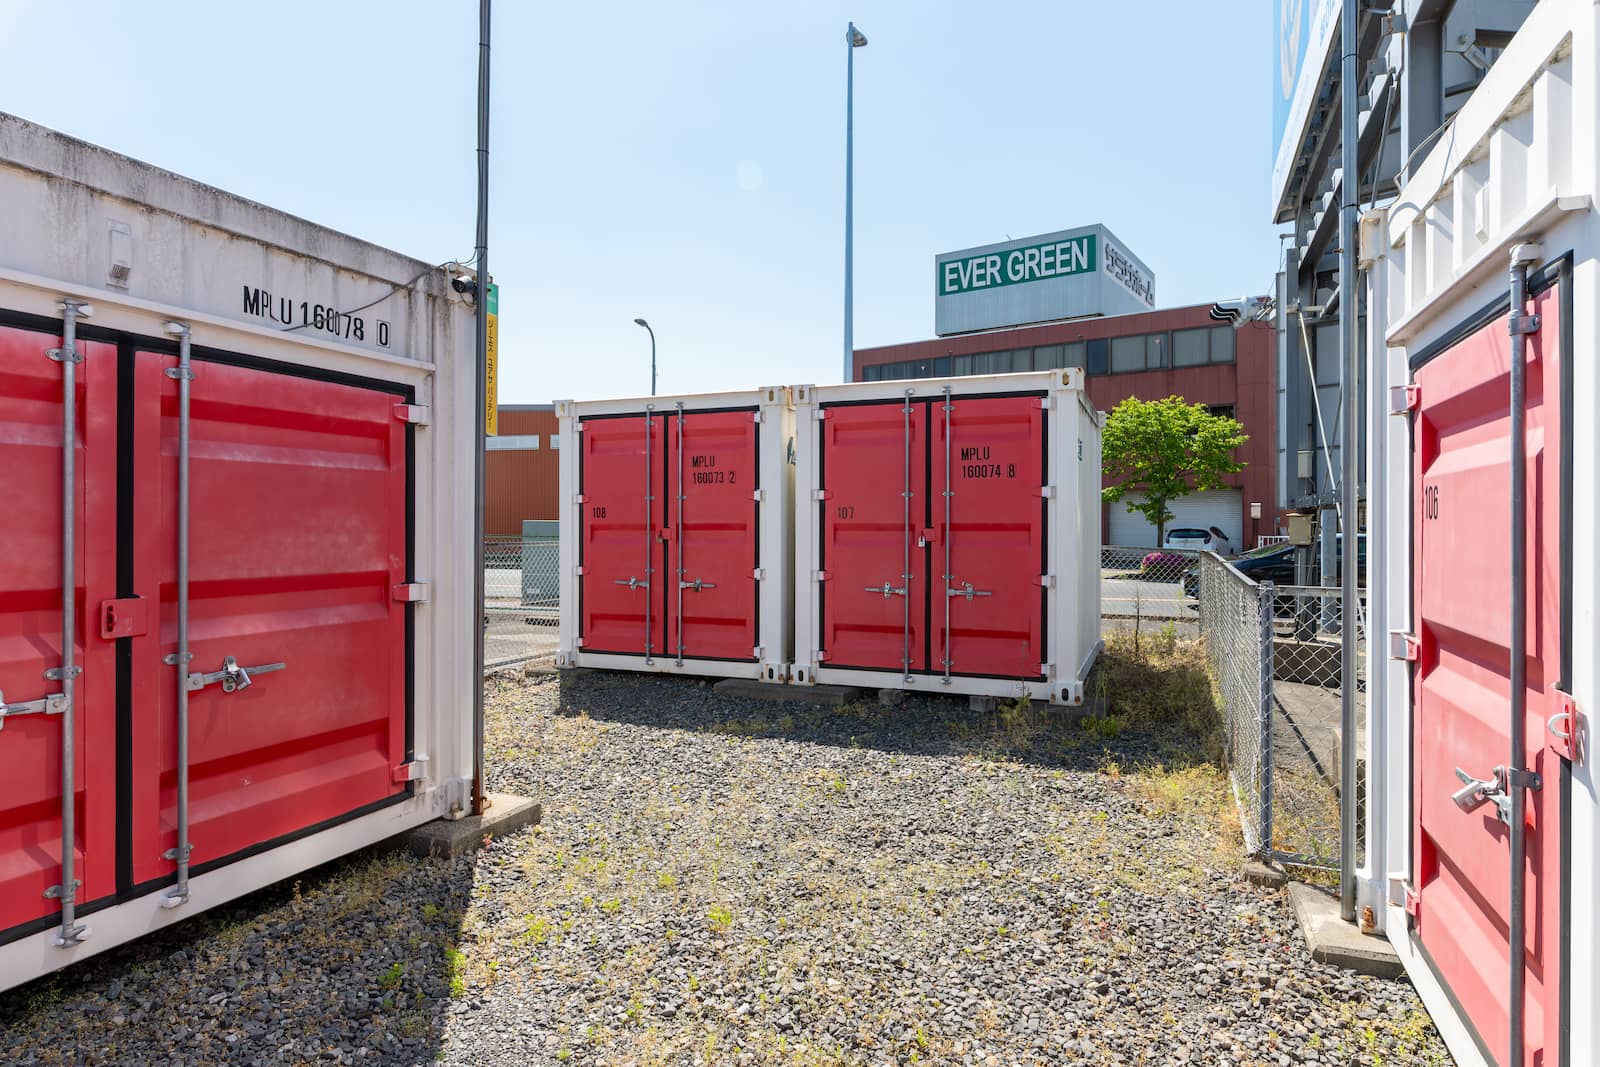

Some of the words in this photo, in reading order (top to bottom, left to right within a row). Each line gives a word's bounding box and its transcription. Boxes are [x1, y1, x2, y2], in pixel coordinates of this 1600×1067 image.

[944, 254, 1002, 292] EVER
[1007, 238, 1089, 282] GREEN
[243, 285, 292, 325] MPLU
[300, 302, 364, 341] 160078
[961, 446, 990, 461] MPLU
[692, 455, 715, 468] MPLU
[693, 471, 725, 485] 160073
[729, 470, 736, 484] 2
[962, 464, 1001, 479] 160074
[1008, 463, 1016, 479] 8
[1425, 485, 1439, 520] 106
[593, 506, 607, 519] 108
[837, 506, 855, 520] 107
